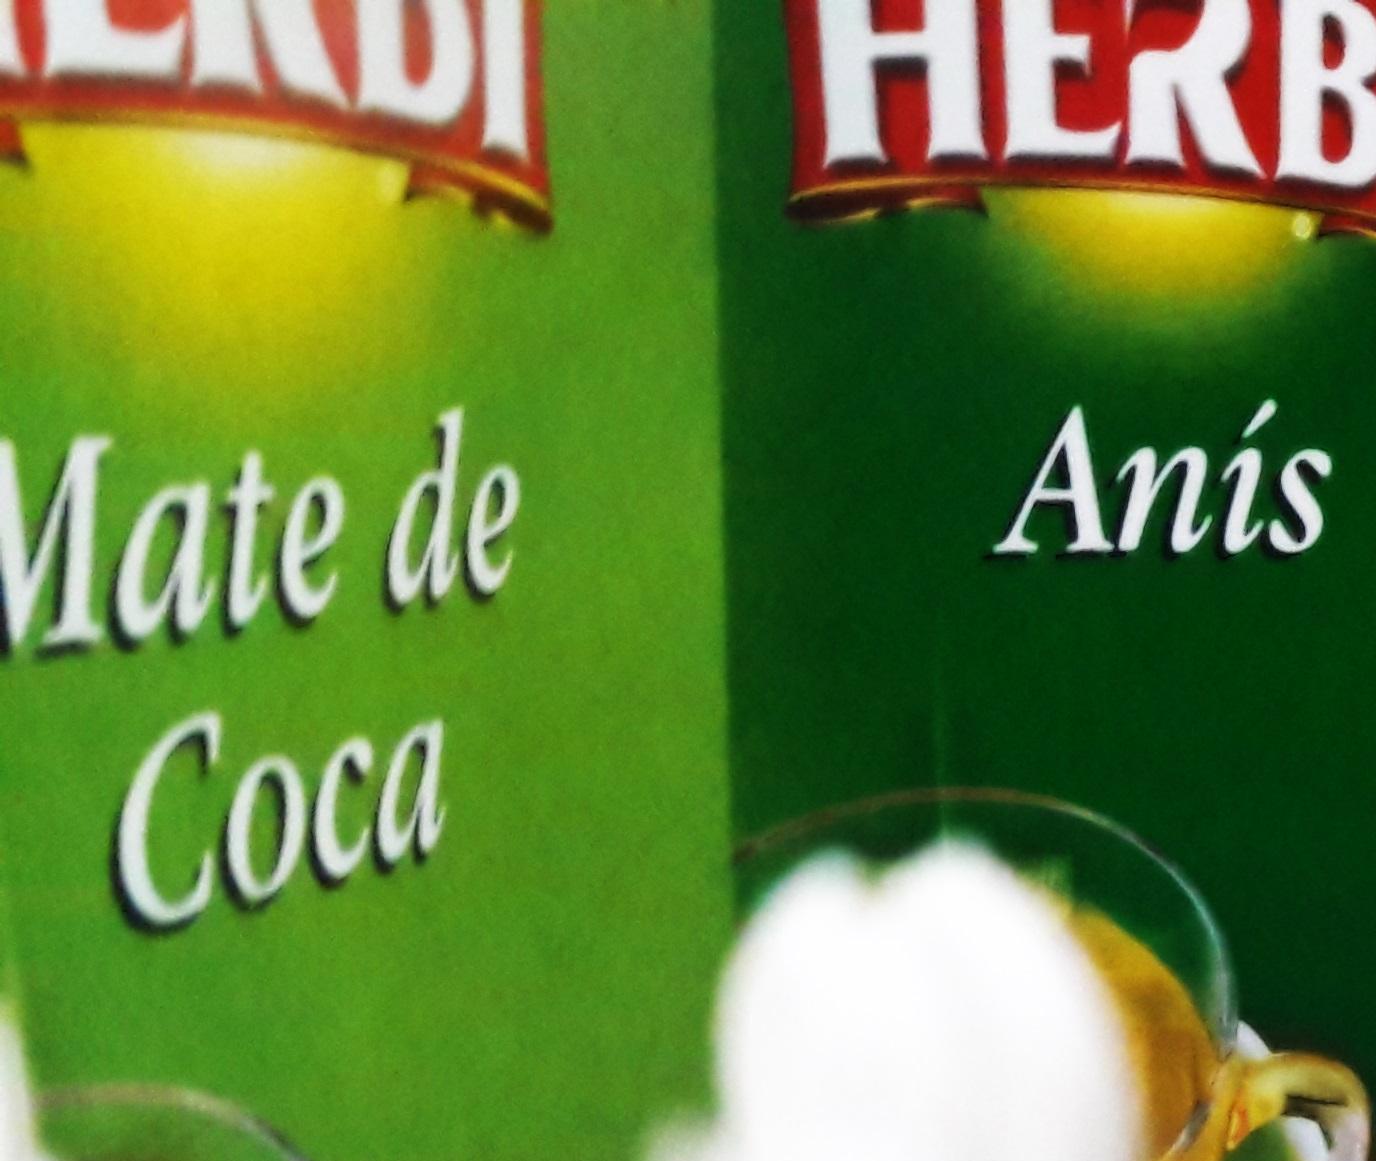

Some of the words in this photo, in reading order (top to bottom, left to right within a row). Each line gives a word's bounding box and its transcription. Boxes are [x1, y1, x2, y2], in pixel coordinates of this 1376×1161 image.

[0, 434, 346, 654] Mate
[386, 405, 521, 608] de
[988, 399, 1334, 560] Anís
[114, 711, 447, 931] Coca
